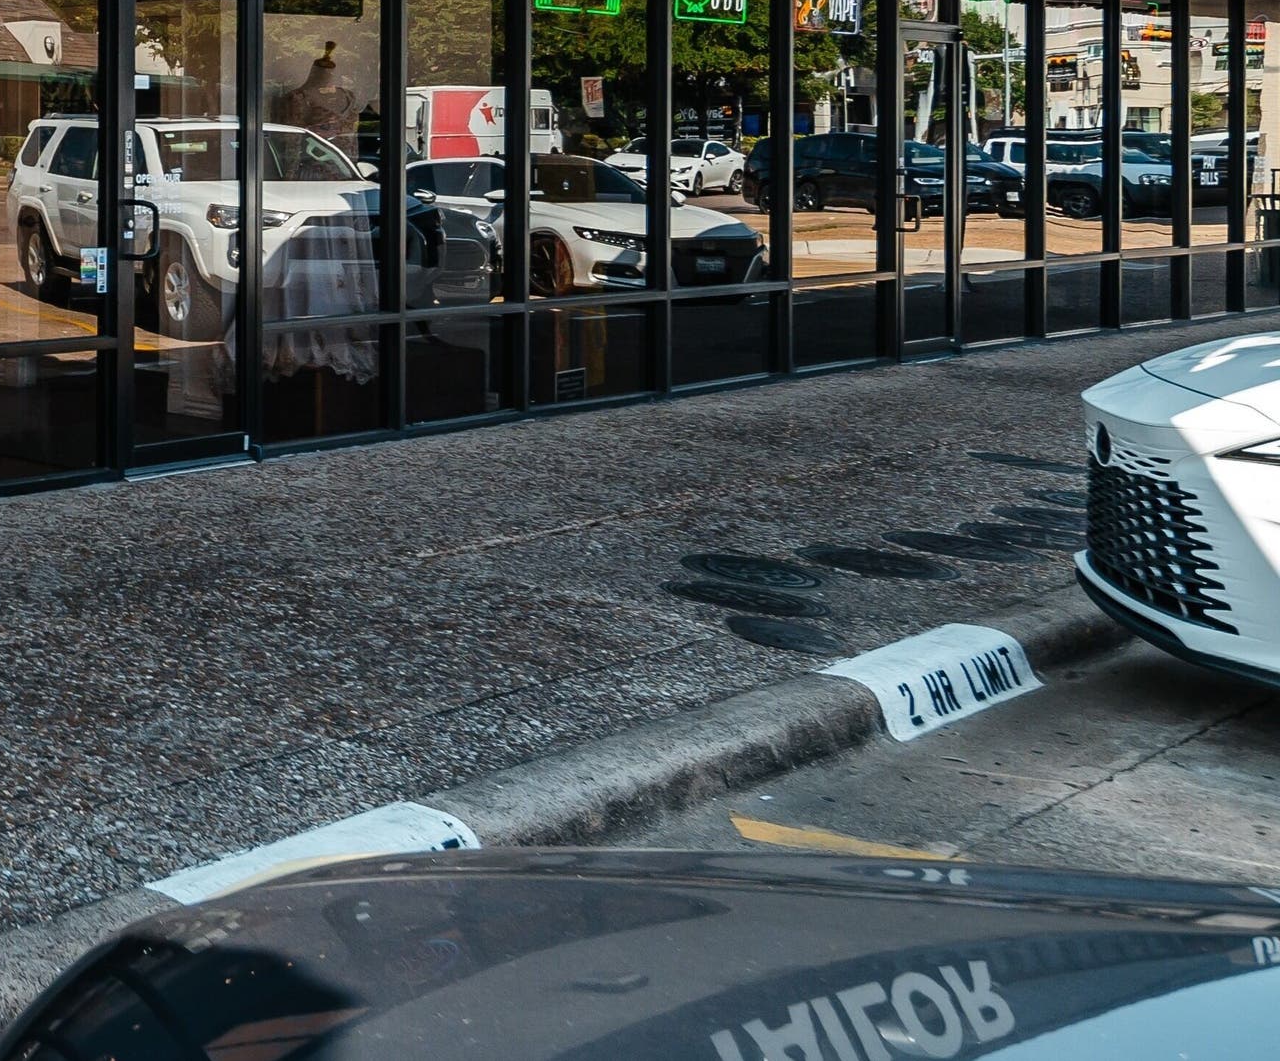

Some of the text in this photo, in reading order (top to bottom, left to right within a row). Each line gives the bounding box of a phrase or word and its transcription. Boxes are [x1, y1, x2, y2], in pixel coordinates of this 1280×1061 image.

[1203, 156, 1216, 169] PAY
[1200, 172, 1219, 185] BILLS
[898, 647, 1022, 726] 2 HR LIMIT
